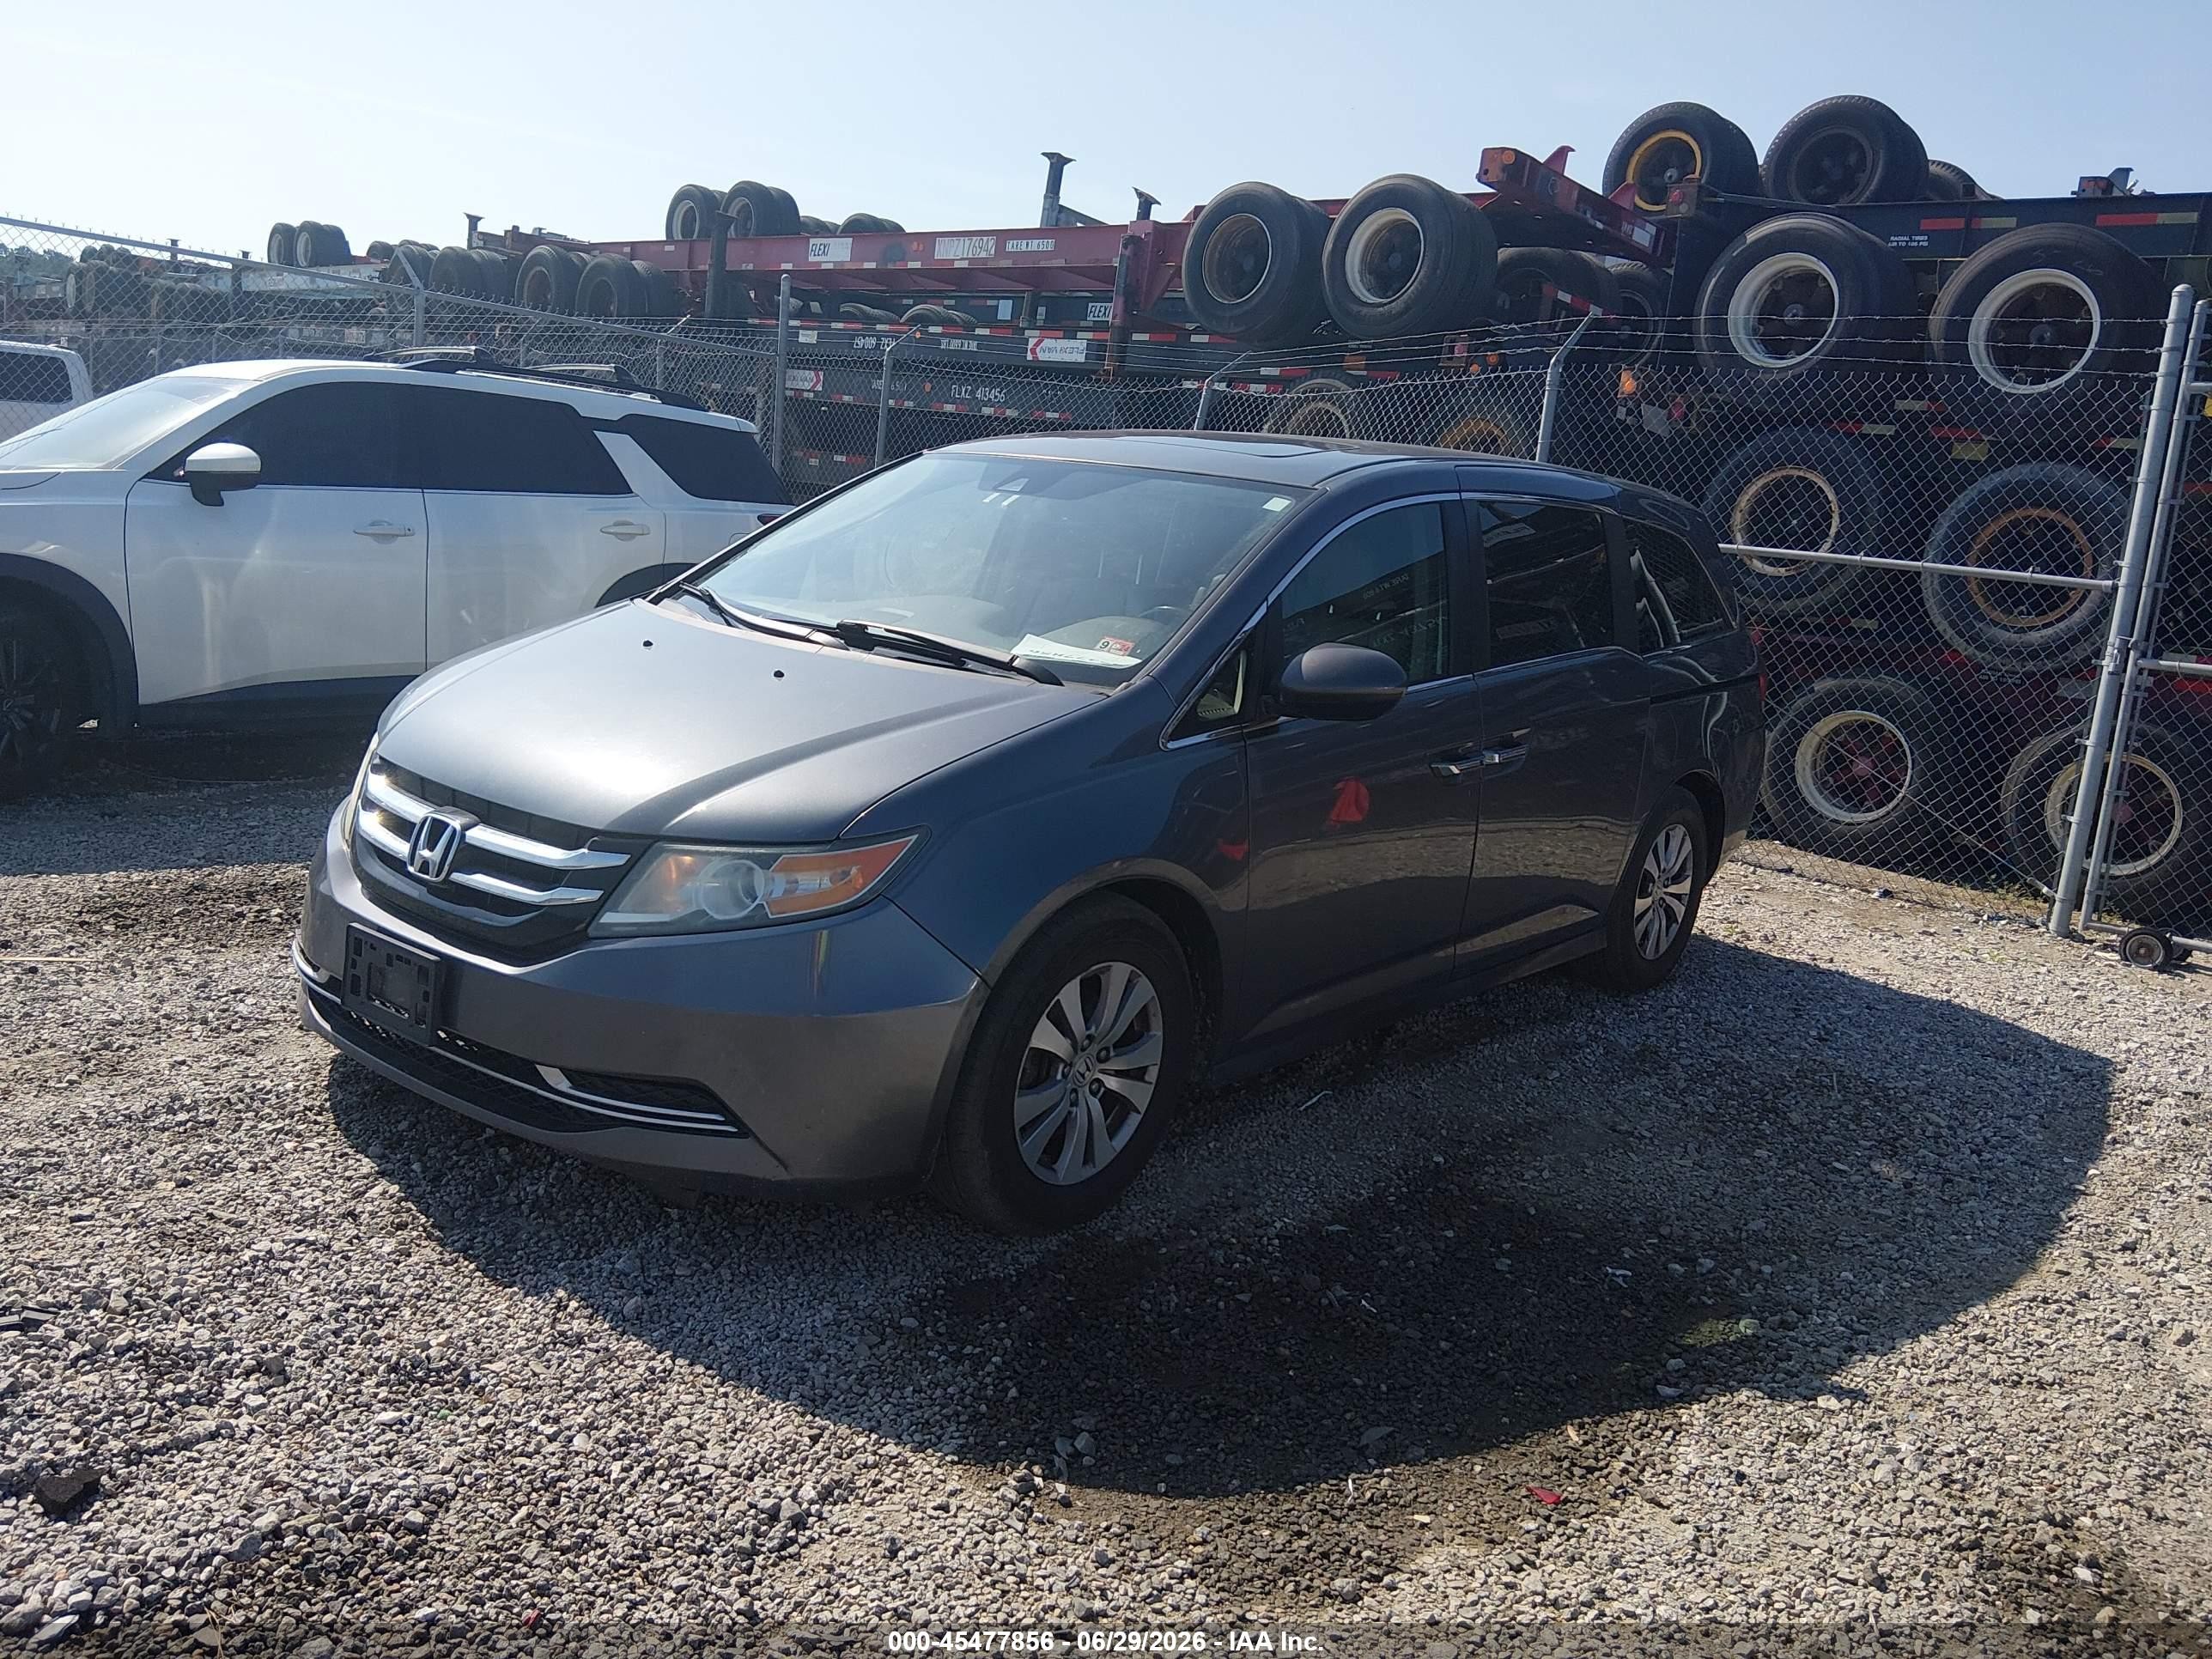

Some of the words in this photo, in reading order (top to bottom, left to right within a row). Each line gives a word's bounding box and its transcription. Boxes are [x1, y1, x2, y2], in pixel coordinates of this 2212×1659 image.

[810, 242, 830, 257] FLEXI
[1006, 240, 1023, 251] TARE
[1036, 240, 1054, 249] 6500
[951, 385, 972, 398] FLXZ
[975, 386, 1006, 402] 413456
[1099, 641, 1109, 649] 9
